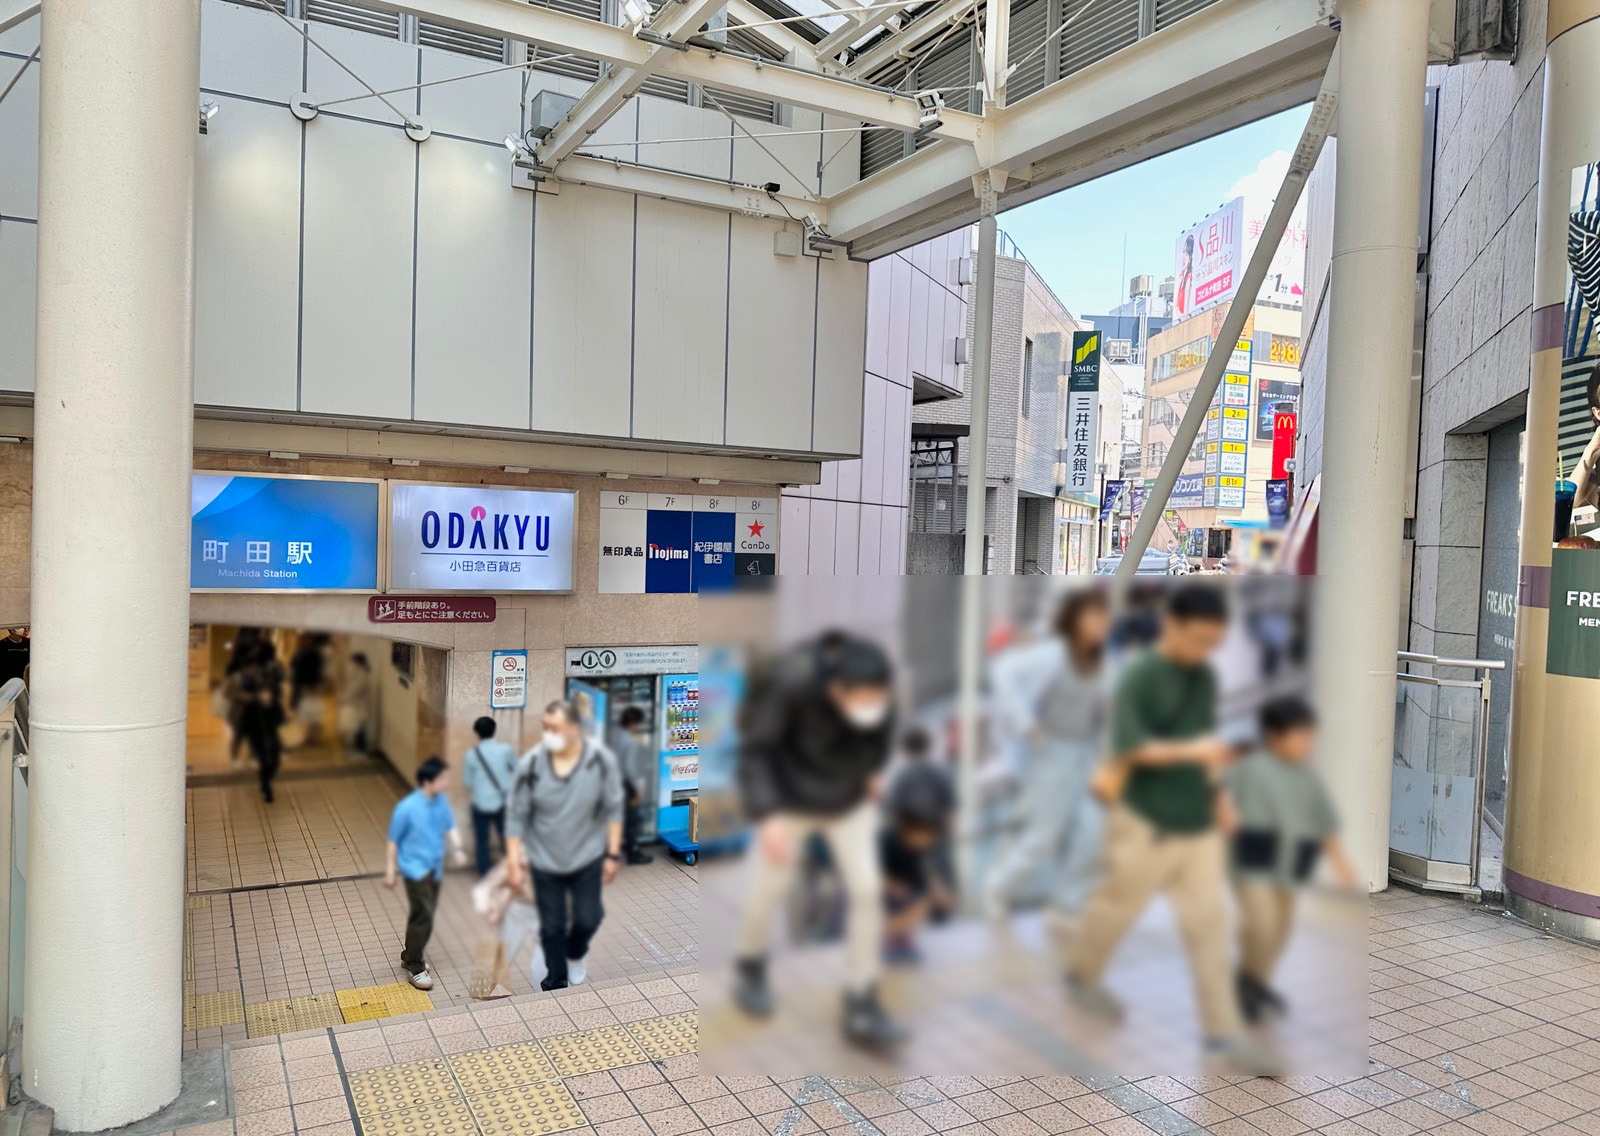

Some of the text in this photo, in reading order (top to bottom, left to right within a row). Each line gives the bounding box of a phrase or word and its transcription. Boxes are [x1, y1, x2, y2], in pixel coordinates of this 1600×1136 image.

[1074, 365, 1098, 373] SMBC
[1072, 397, 1090, 487] 三井住友銀行
[618, 495, 630, 506] 6F
[665, 497, 676, 507] 7F
[709, 499, 720, 509] 8F
[751, 501, 762, 511] 8F
[421, 506, 550, 551] ODAKYU
[741, 541, 770, 550] CanDo
[602, 545, 644, 557] 無印良品
[703, 553, 723, 565] 書店
[449, 560, 522, 572] 小田急百貨店
[218, 569, 298, 579] Machida Station
[397, 601, 451, 610] 手前階段あり。
[397, 610, 490, 620] 足もとにご注意ください。
